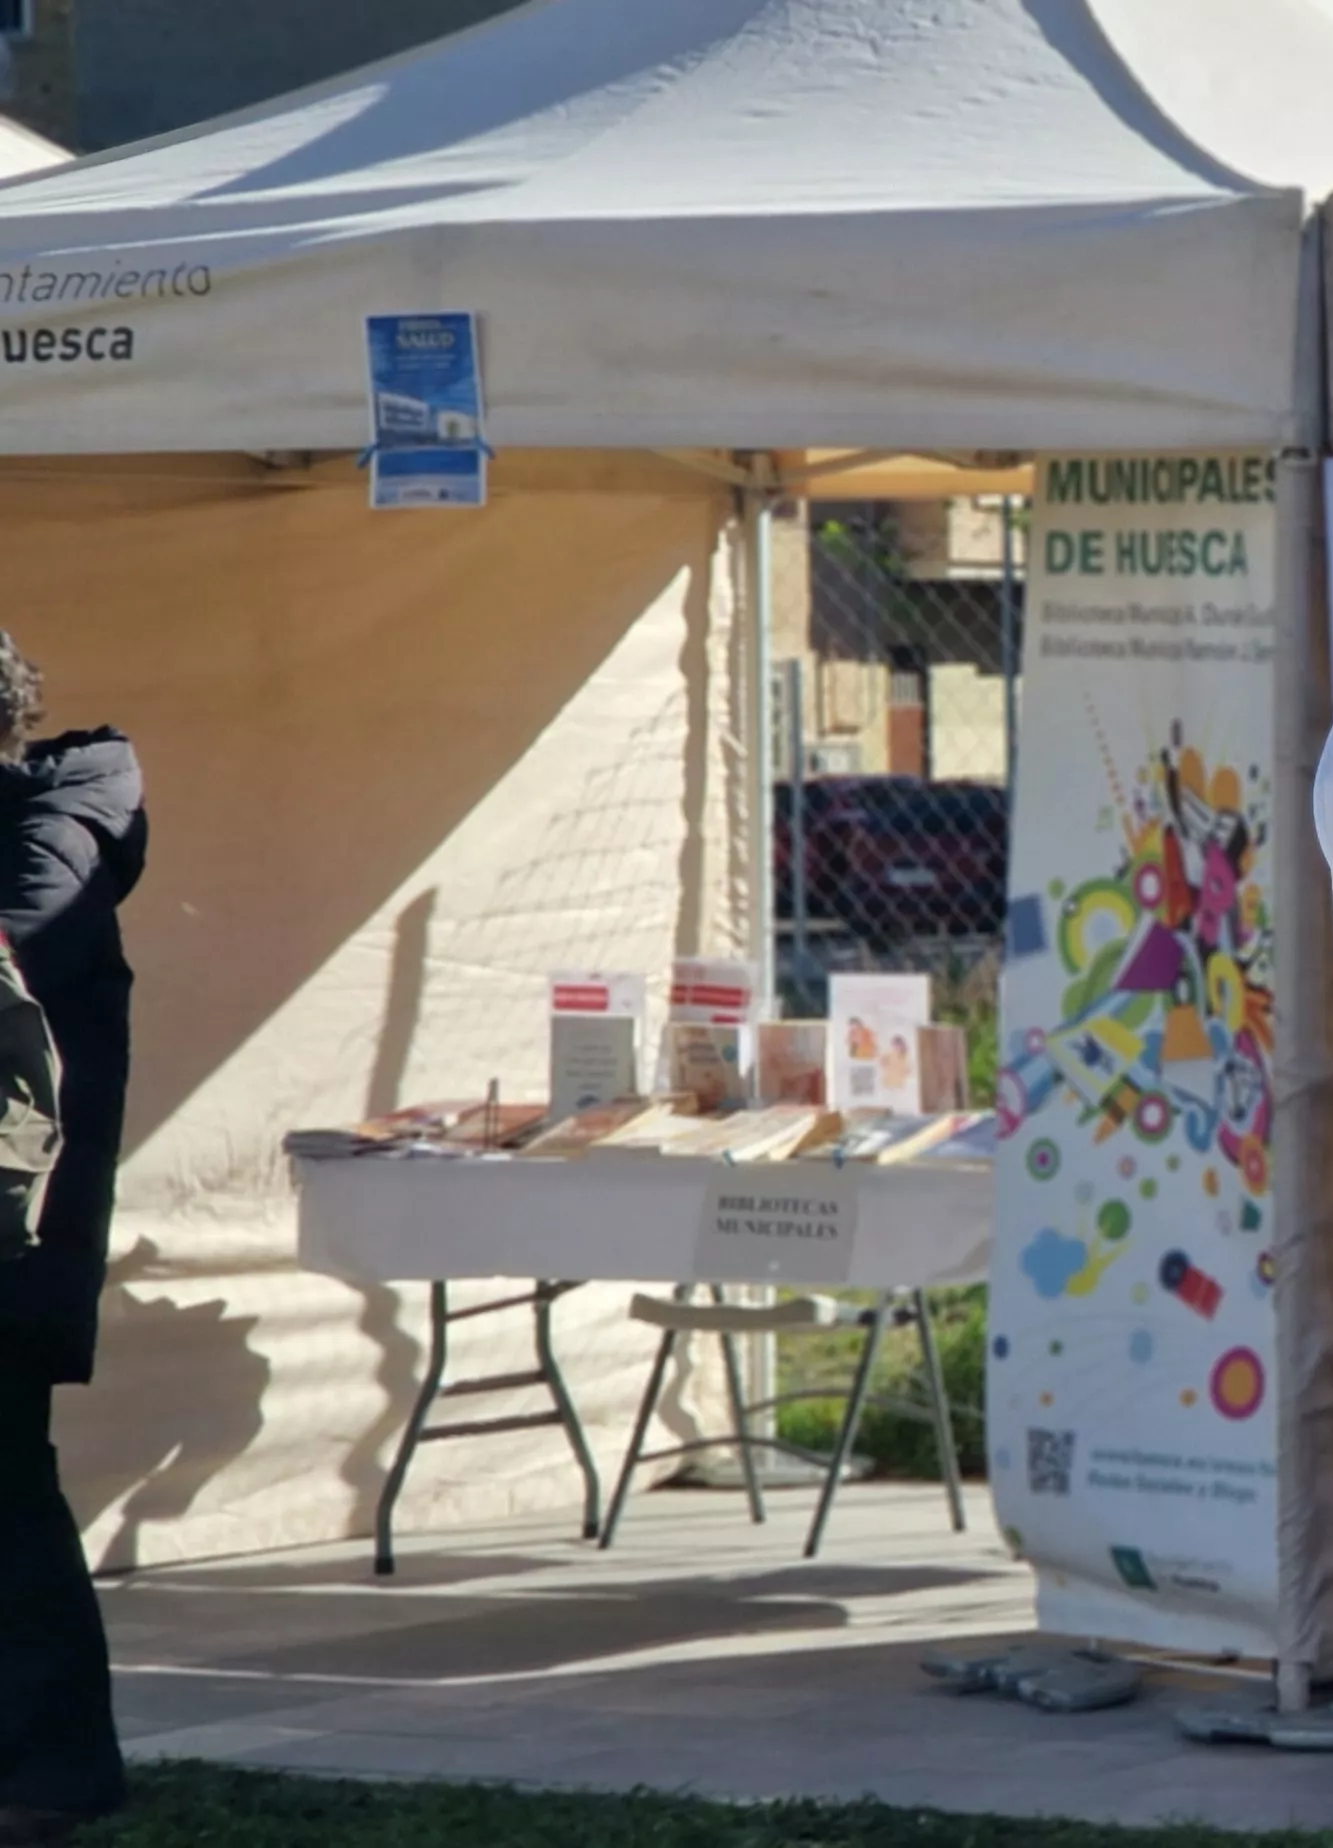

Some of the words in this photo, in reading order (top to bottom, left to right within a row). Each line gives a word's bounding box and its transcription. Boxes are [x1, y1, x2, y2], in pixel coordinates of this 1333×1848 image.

[1, 326, 134, 363] uesca
[1047, 457, 1277, 503] MUNICIPALES
[1046, 530, 1105, 574] DE
[1116, 528, 1248, 576] HUESCA
[718, 1195, 838, 1216] BIBLIOTECAS
[716, 1216, 838, 1239] MUNICIPALES
